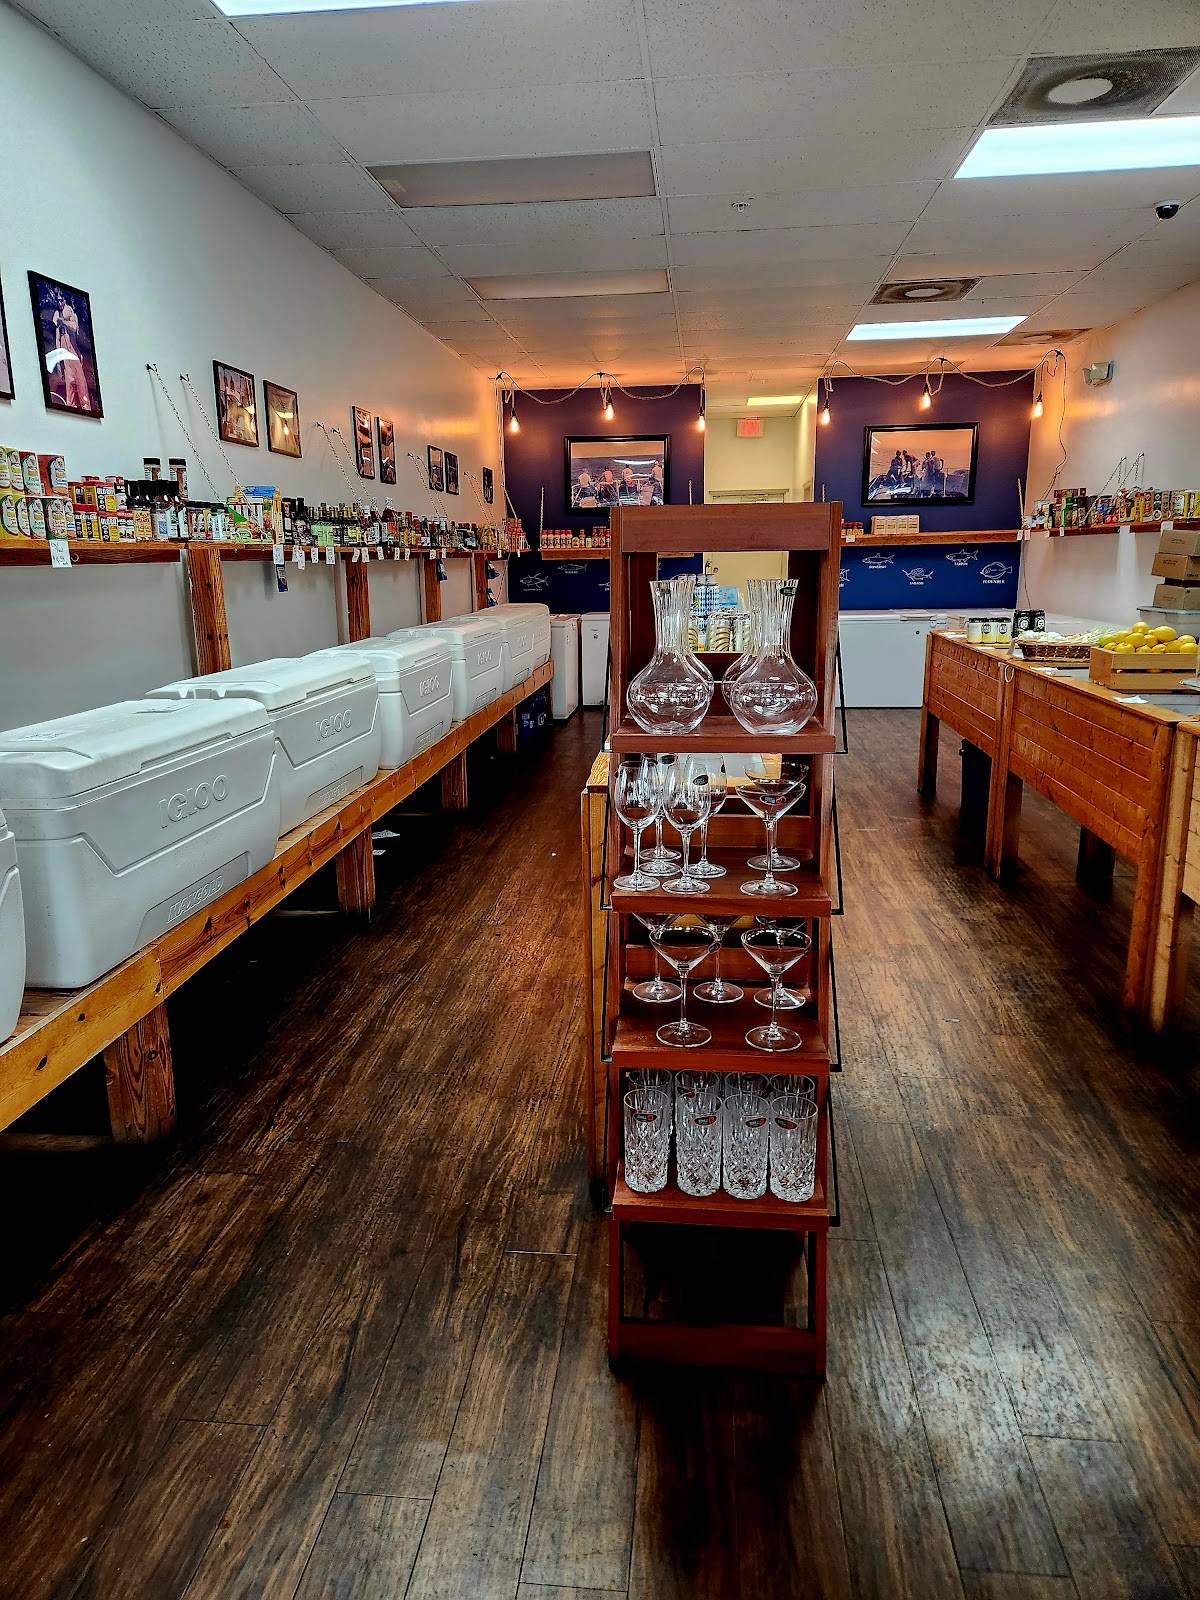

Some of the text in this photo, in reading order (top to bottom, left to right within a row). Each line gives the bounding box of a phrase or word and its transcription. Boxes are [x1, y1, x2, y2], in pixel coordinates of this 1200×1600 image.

[419, 674, 440, 698] IGLOO
[315, 708, 352, 742] IGLOO
[159, 774, 230, 829] IGLOO
